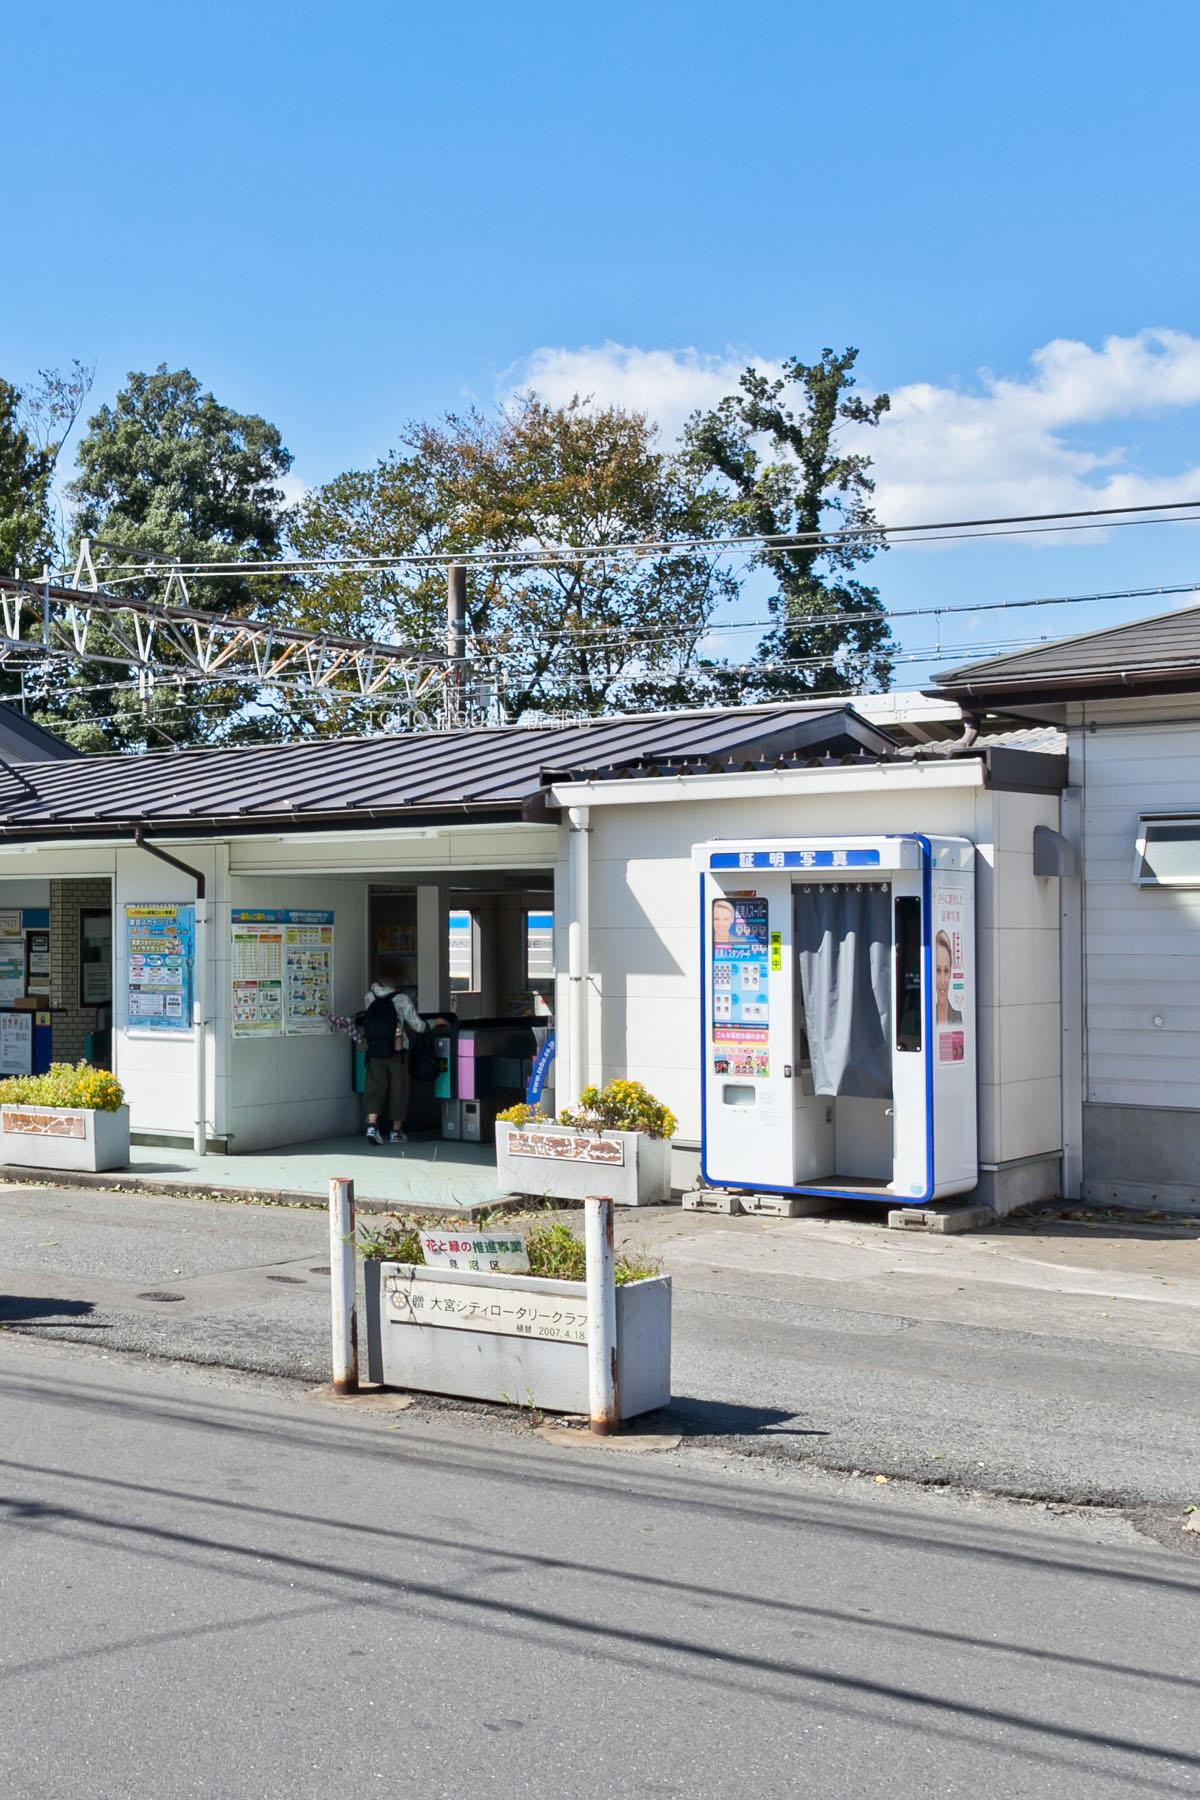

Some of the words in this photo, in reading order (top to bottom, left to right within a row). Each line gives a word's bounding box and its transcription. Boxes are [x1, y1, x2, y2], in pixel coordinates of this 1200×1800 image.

[739, 851, 849, 868] 証明写真
[449, 1258, 501, 1271] 見沼区
[538, 1326, 585, 1341] 2007.4.18
